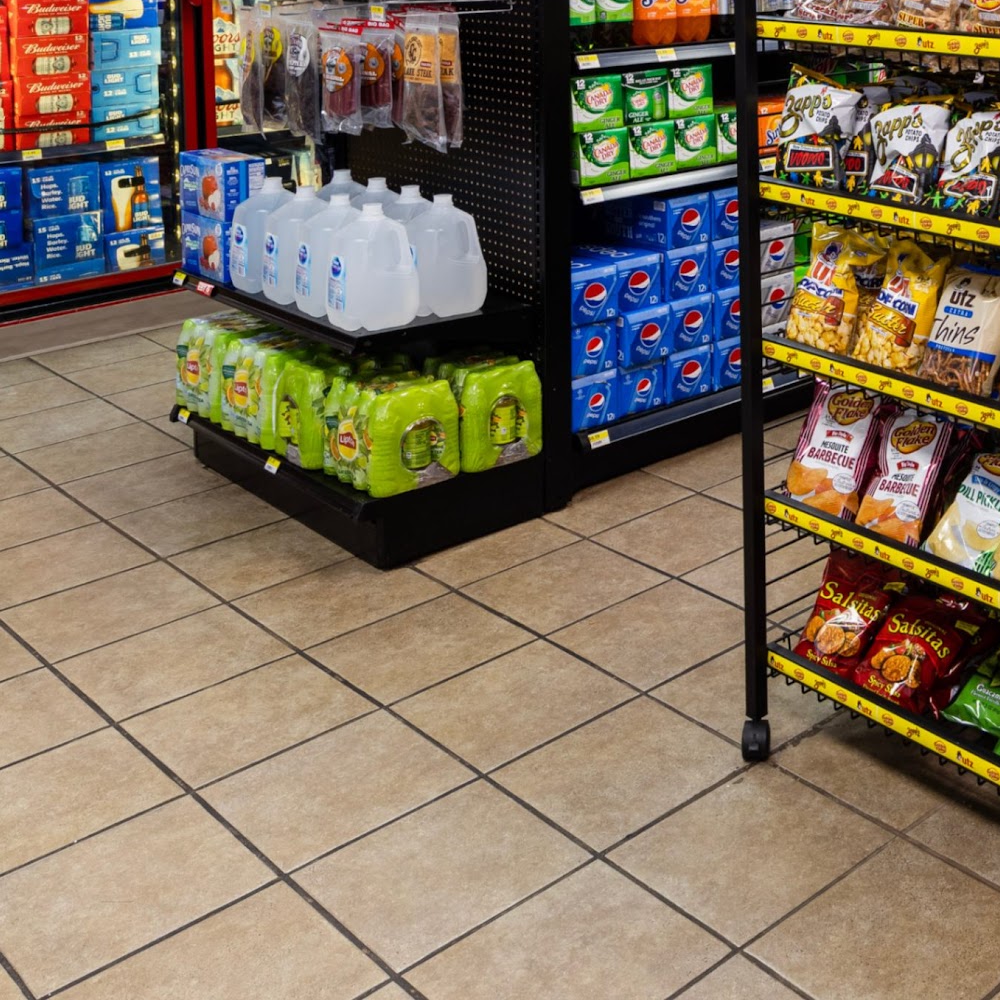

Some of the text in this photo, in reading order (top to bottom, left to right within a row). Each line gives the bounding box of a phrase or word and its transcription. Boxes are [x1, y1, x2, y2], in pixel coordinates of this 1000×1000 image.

[24, 3, 82, 15] Budweiser
[899, 11, 925, 28] SUPER
[213, 33, 240, 43] oors
[822, 31, 834, 41] utz
[23, 43, 81, 55] Budweiser
[922, 39, 935, 49] utz
[27, 81, 84, 94] Budweiser
[949, 290, 976, 308] utz
[833, 407, 866, 421] Flake
[893, 426, 935, 439] Golden
[821, 439, 850, 454] MESQUITE
[896, 435, 931, 449] Flake
[806, 447, 857, 470] BARBECUE
[878, 479, 920, 498] BARBECUE
[958, 484, 976, 499] DILL
[821, 580, 881, 622] Salsitas
[888, 613, 950, 659] Salsitas
[867, 674, 884, 690] Spicy
